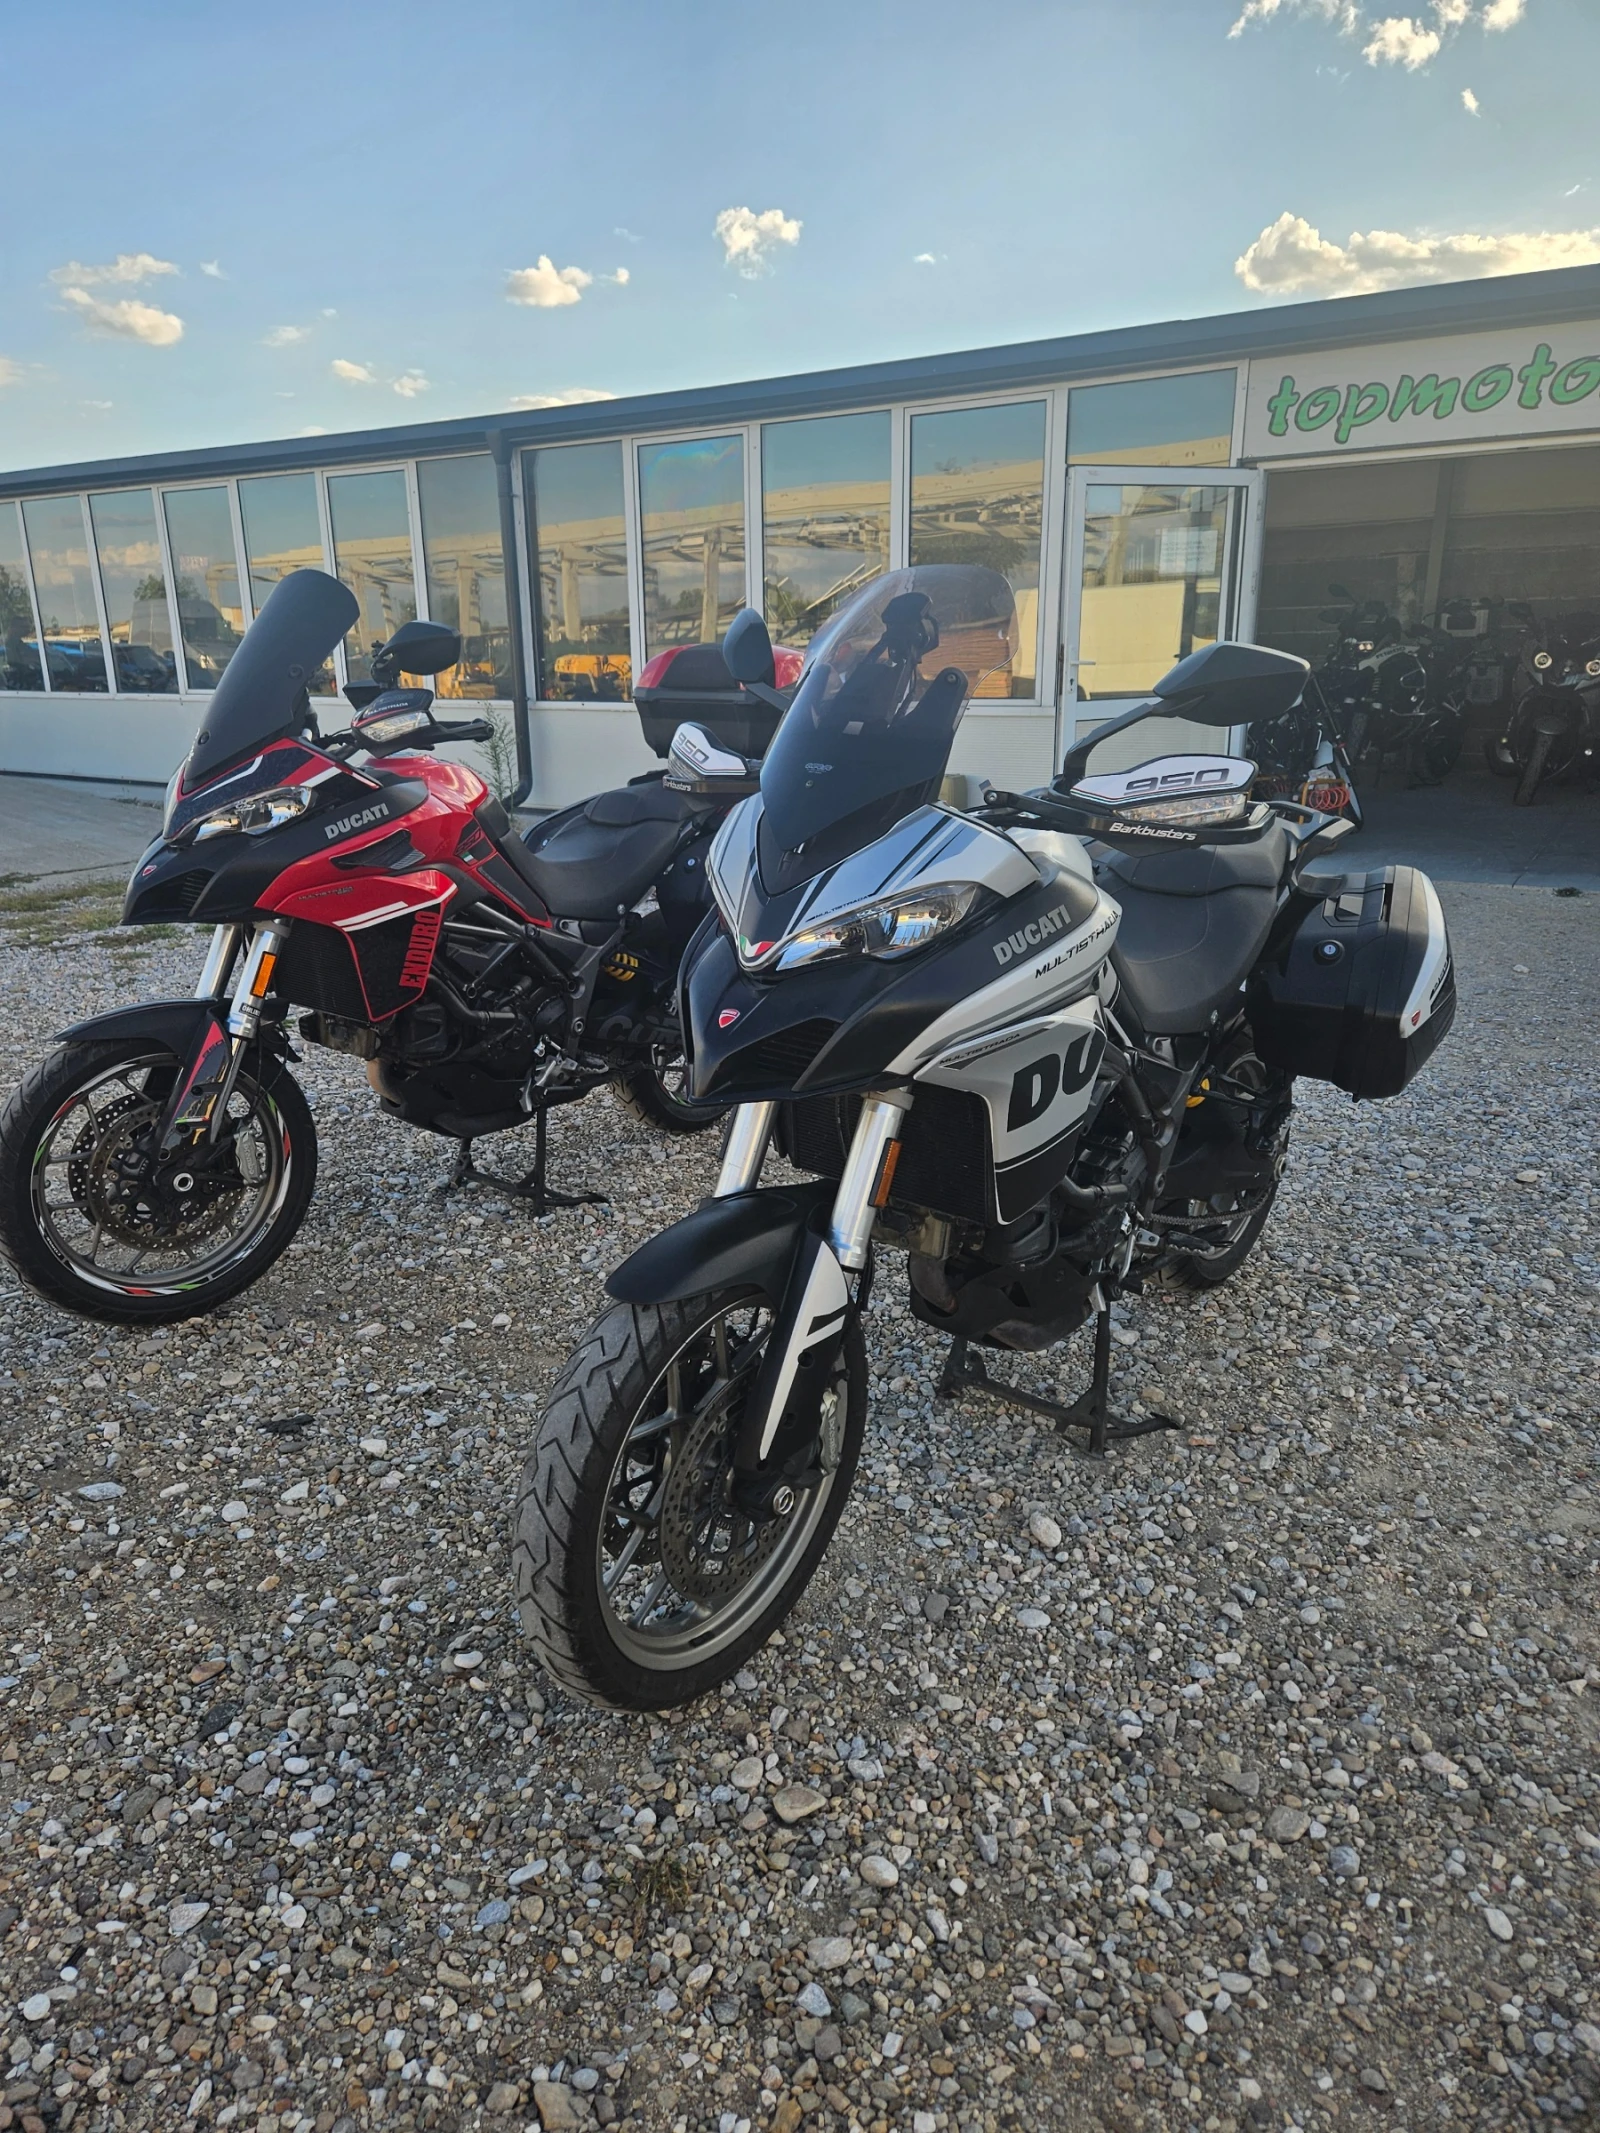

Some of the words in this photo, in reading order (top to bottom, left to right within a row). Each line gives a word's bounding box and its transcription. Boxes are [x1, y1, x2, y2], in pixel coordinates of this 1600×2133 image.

[1267, 342, 1600, 445] topmoto
[673, 732, 710, 765] 950
[1124, 768, 1230, 796] 950
[324, 802, 390, 840] DUCATI
[1109, 821, 1198, 842] Barkbusters
[399, 910, 441, 989] ENDURO
[992, 904, 1072, 966] DUCATI
[939, 1033, 1020, 1065] MULTISTRADA
